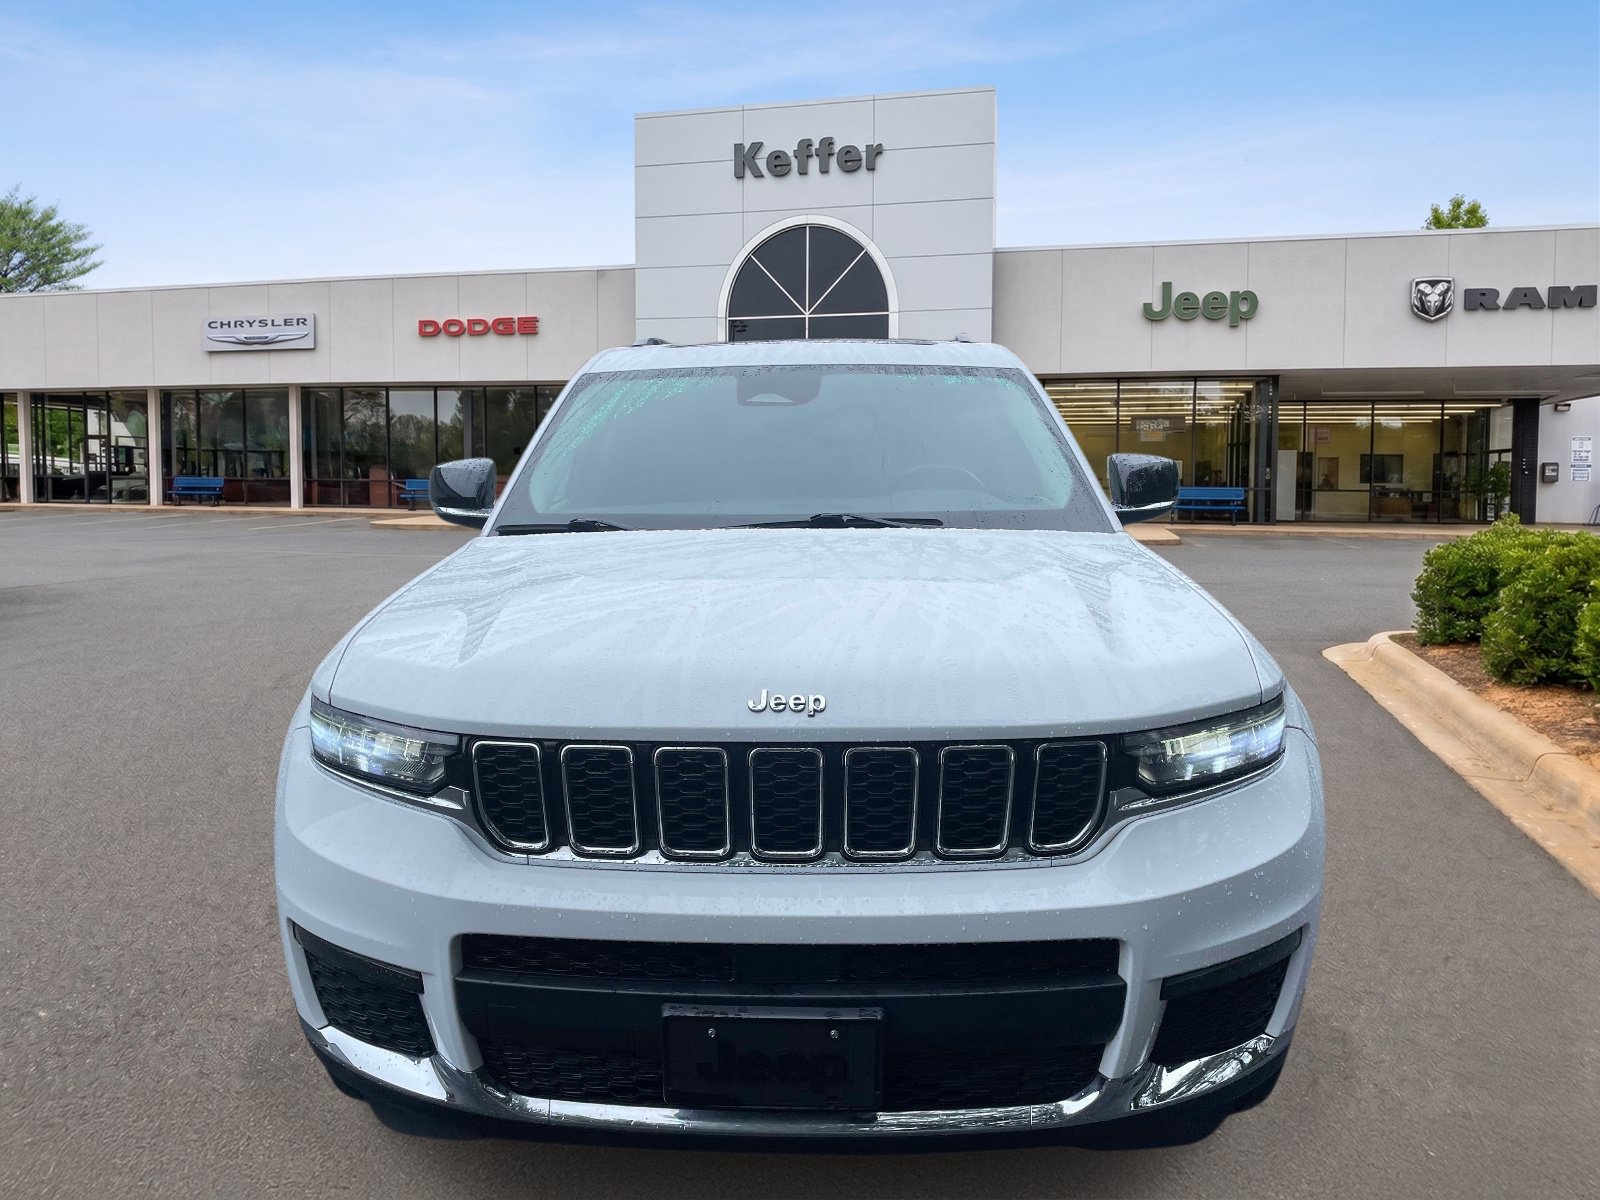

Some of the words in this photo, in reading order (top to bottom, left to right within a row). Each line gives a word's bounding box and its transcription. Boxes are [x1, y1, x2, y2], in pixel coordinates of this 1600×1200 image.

[733, 136, 884, 179] Keffer
[1142, 281, 1260, 328] Jeep
[1463, 284, 1599, 311] RAM
[207, 317, 309, 330] CHRYSLER
[418, 316, 540, 337] DODGE
[747, 688, 827, 718] Jeep
[693, 1039, 850, 1093] Jeep
